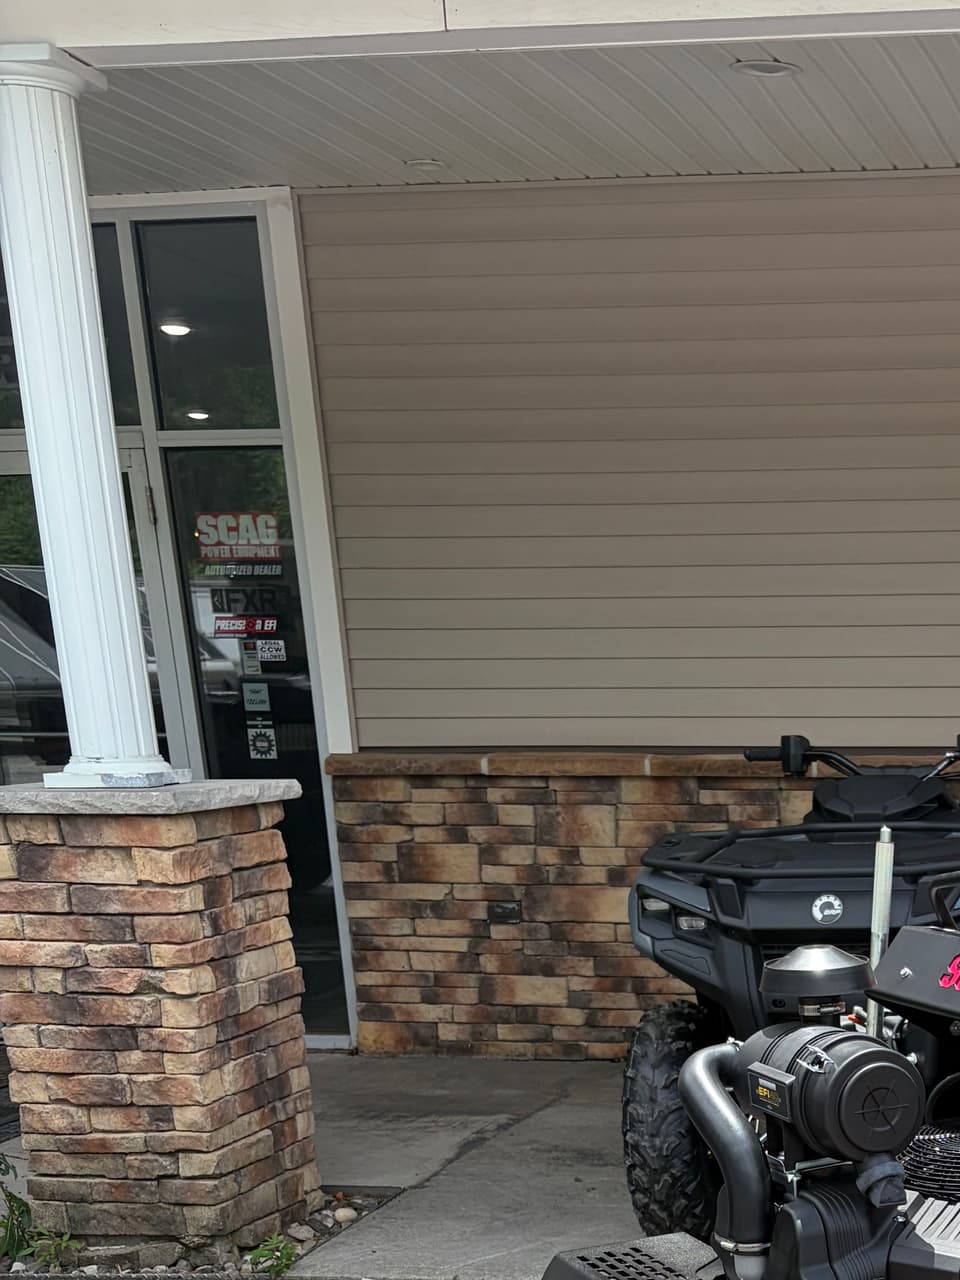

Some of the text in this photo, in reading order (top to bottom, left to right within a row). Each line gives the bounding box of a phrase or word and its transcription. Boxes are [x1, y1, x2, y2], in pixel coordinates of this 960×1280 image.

[197, 514, 279, 545] SCAG
[200, 546, 231, 558] POWER
[253, 565, 282, 575] DEALER
